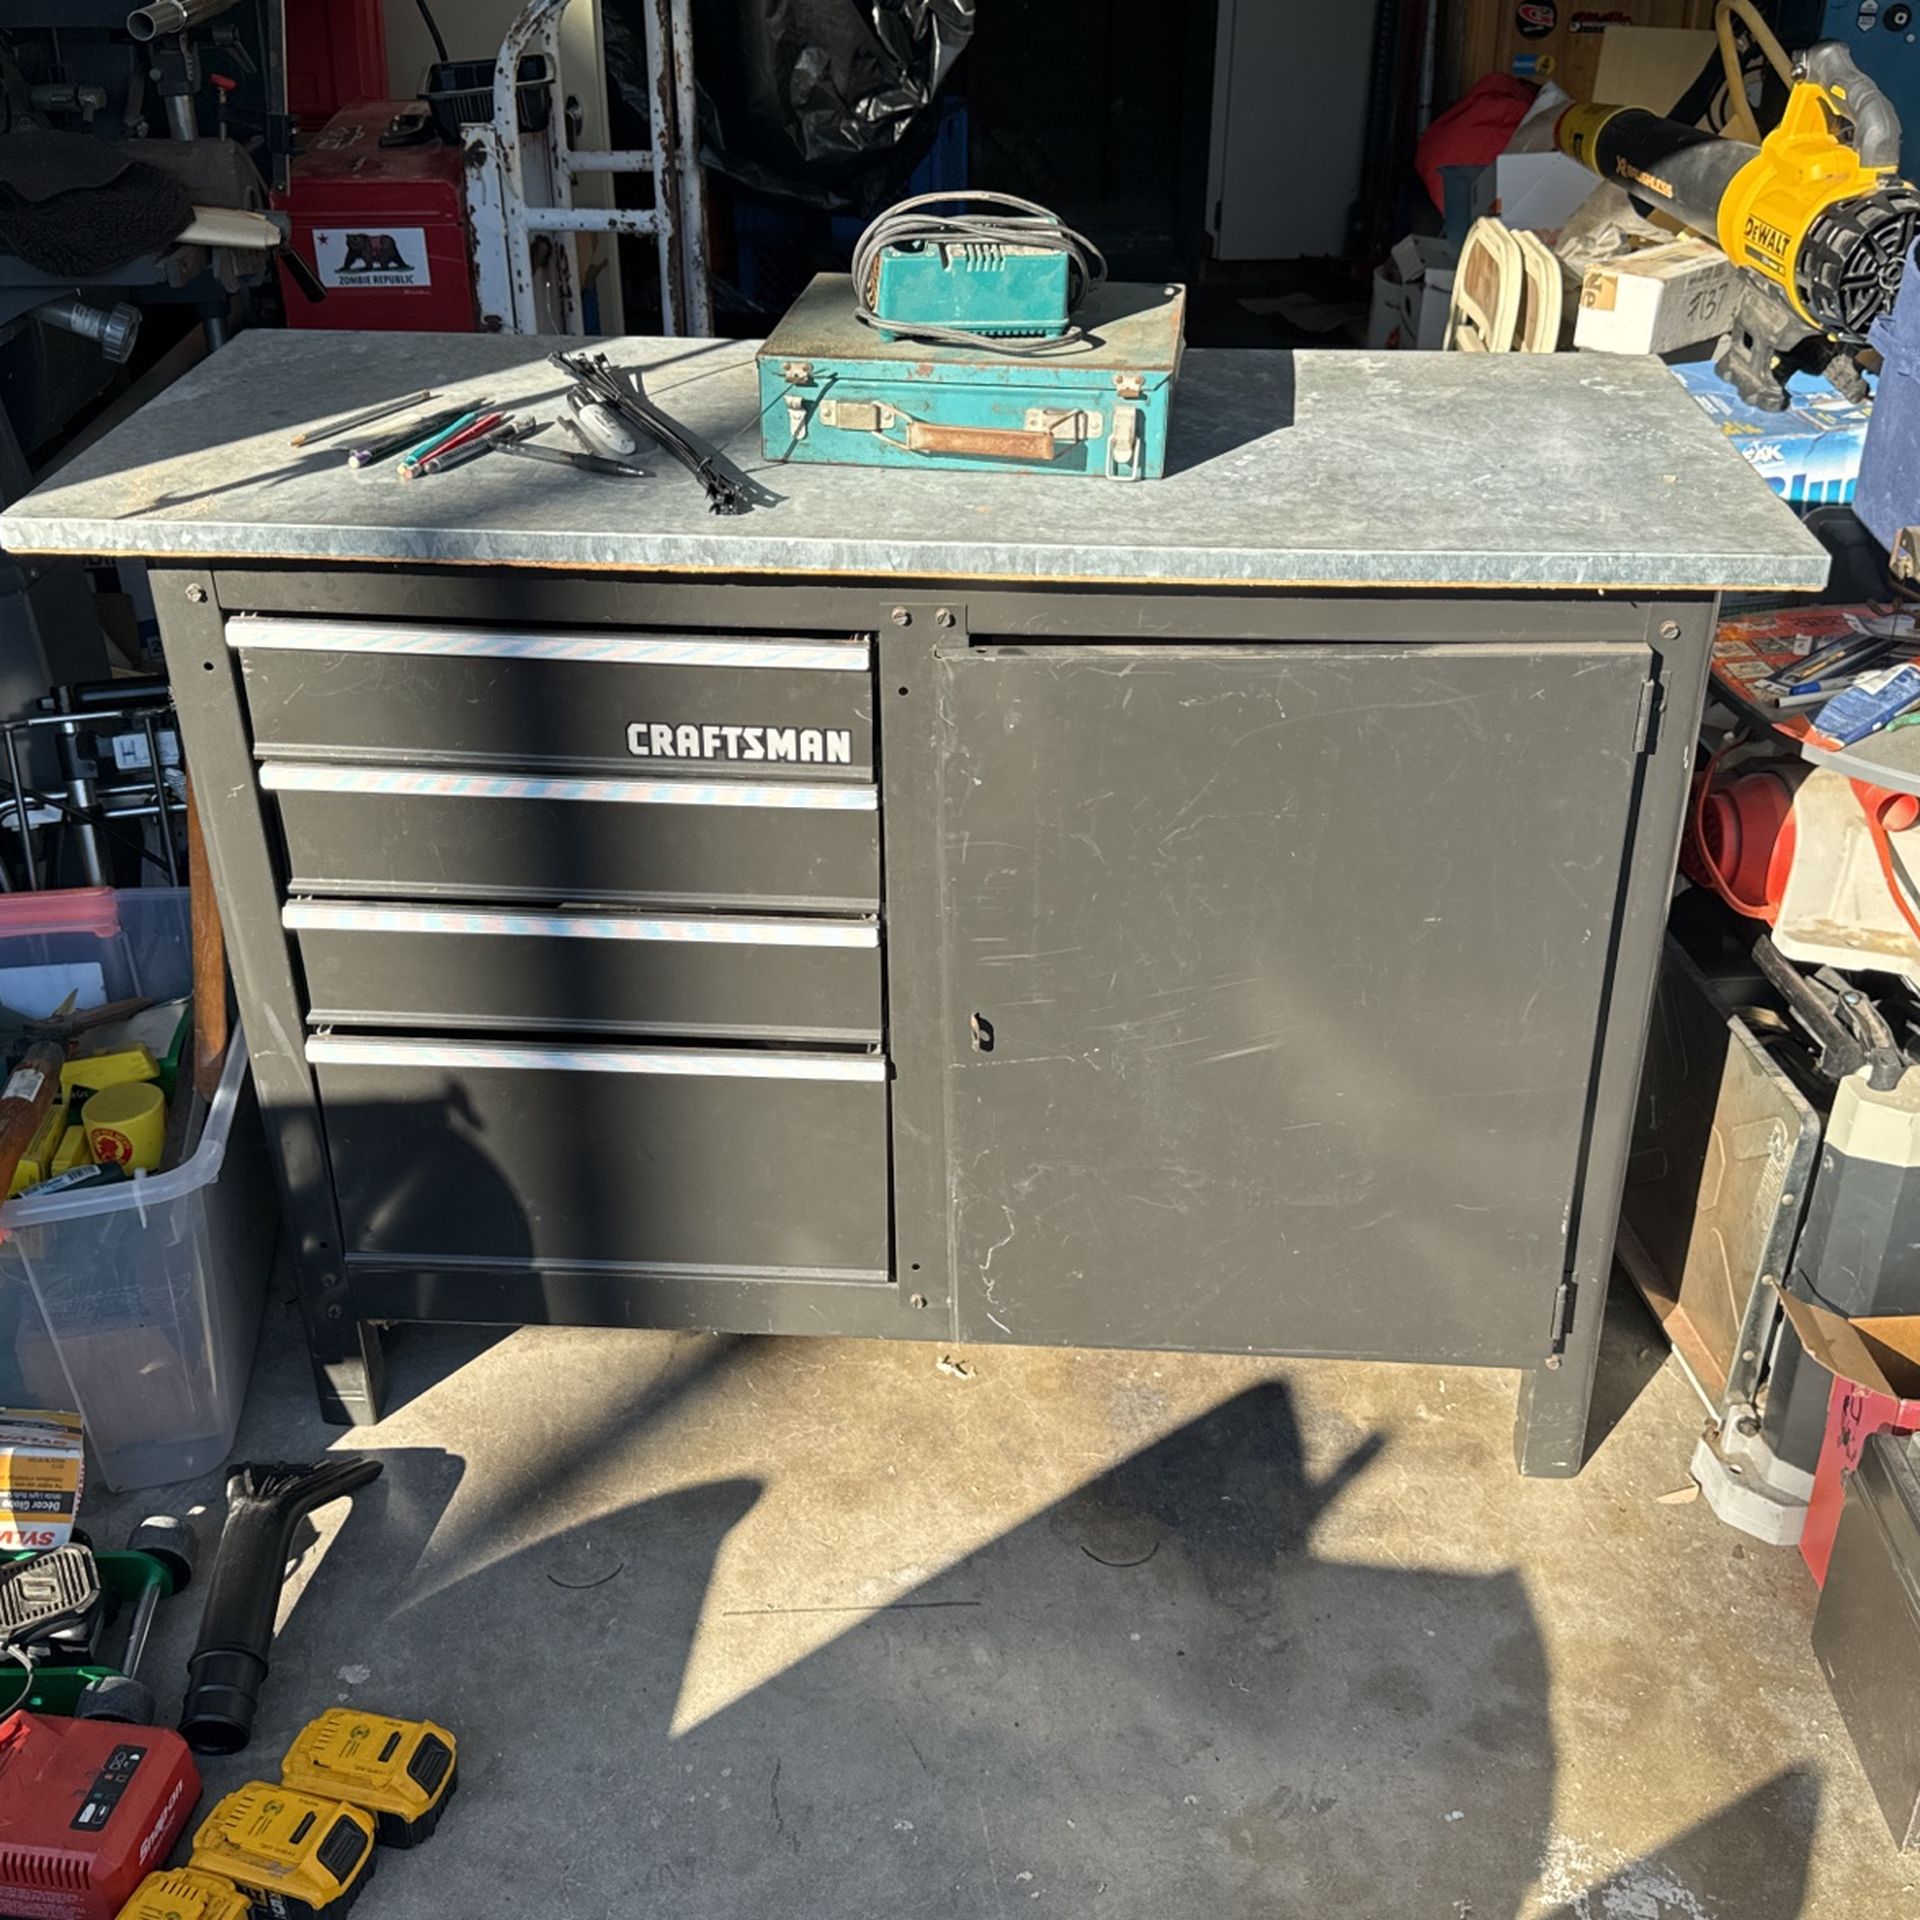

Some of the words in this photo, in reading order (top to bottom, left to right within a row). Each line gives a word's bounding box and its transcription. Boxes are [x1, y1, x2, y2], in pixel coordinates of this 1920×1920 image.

[339, 276, 371, 285] ZOMBIE
[373, 275, 414, 284] REPUBLIC
[625, 722, 852, 765] CRAFTSMAN
